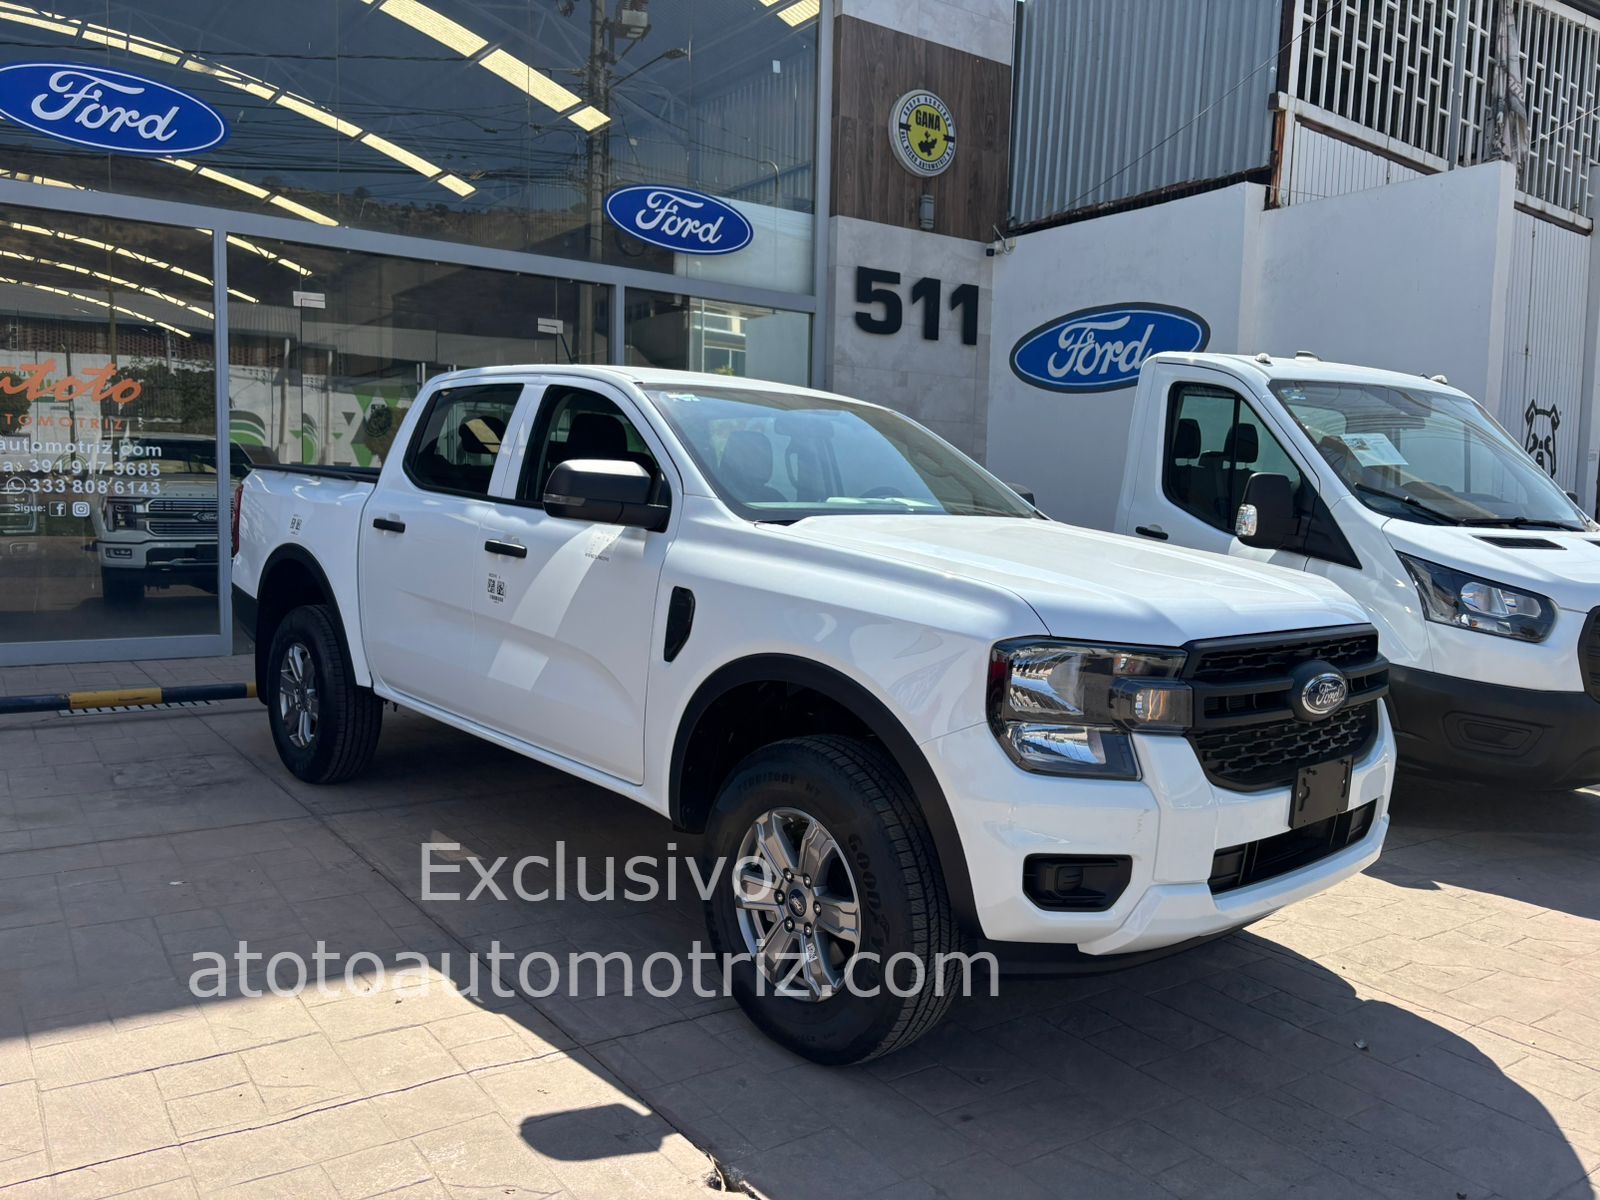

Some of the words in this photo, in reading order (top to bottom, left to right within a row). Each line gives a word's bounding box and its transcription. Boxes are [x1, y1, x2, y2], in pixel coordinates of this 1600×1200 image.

[31, 70, 180, 142] Ford
[915, 109, 941, 131] GANA
[635, 191, 724, 244] Ford
[855, 266, 979, 345] 511
[1048, 315, 1155, 378] Ford
[29, 459, 63, 473] 391
[72, 460, 106, 475] 917
[114, 462, 160, 476] 3685
[30, 479, 66, 493] 333
[73, 480, 108, 494] 808
[115, 481, 161, 495] 6143
[1315, 682, 1341, 705] Ford
